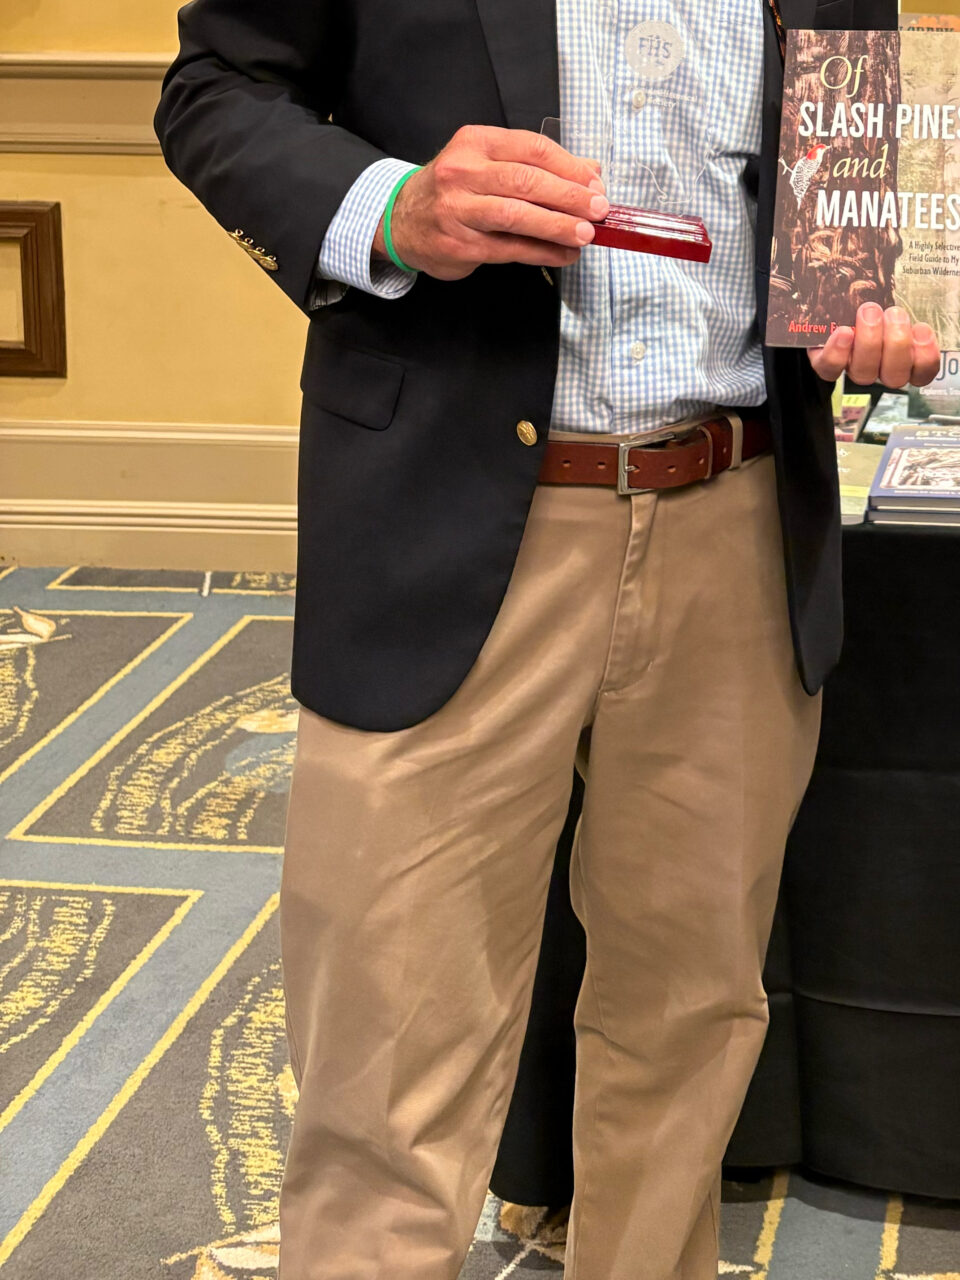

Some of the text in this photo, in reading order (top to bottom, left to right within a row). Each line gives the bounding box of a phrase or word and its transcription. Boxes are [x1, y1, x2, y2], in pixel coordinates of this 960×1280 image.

[820, 55, 868, 98] Of
[798, 101, 884, 139] SLASH
[833, 144, 888, 180] and
[914, 241, 933, 252] Highly
[935, 242, 960, 252] Selective
[908, 254, 923, 262] Field
[924, 254, 942, 264] Guide
[950, 256, 960, 267] My
[902, 266, 932, 274] Suburban
[788, 320, 827, 334] Andrew
